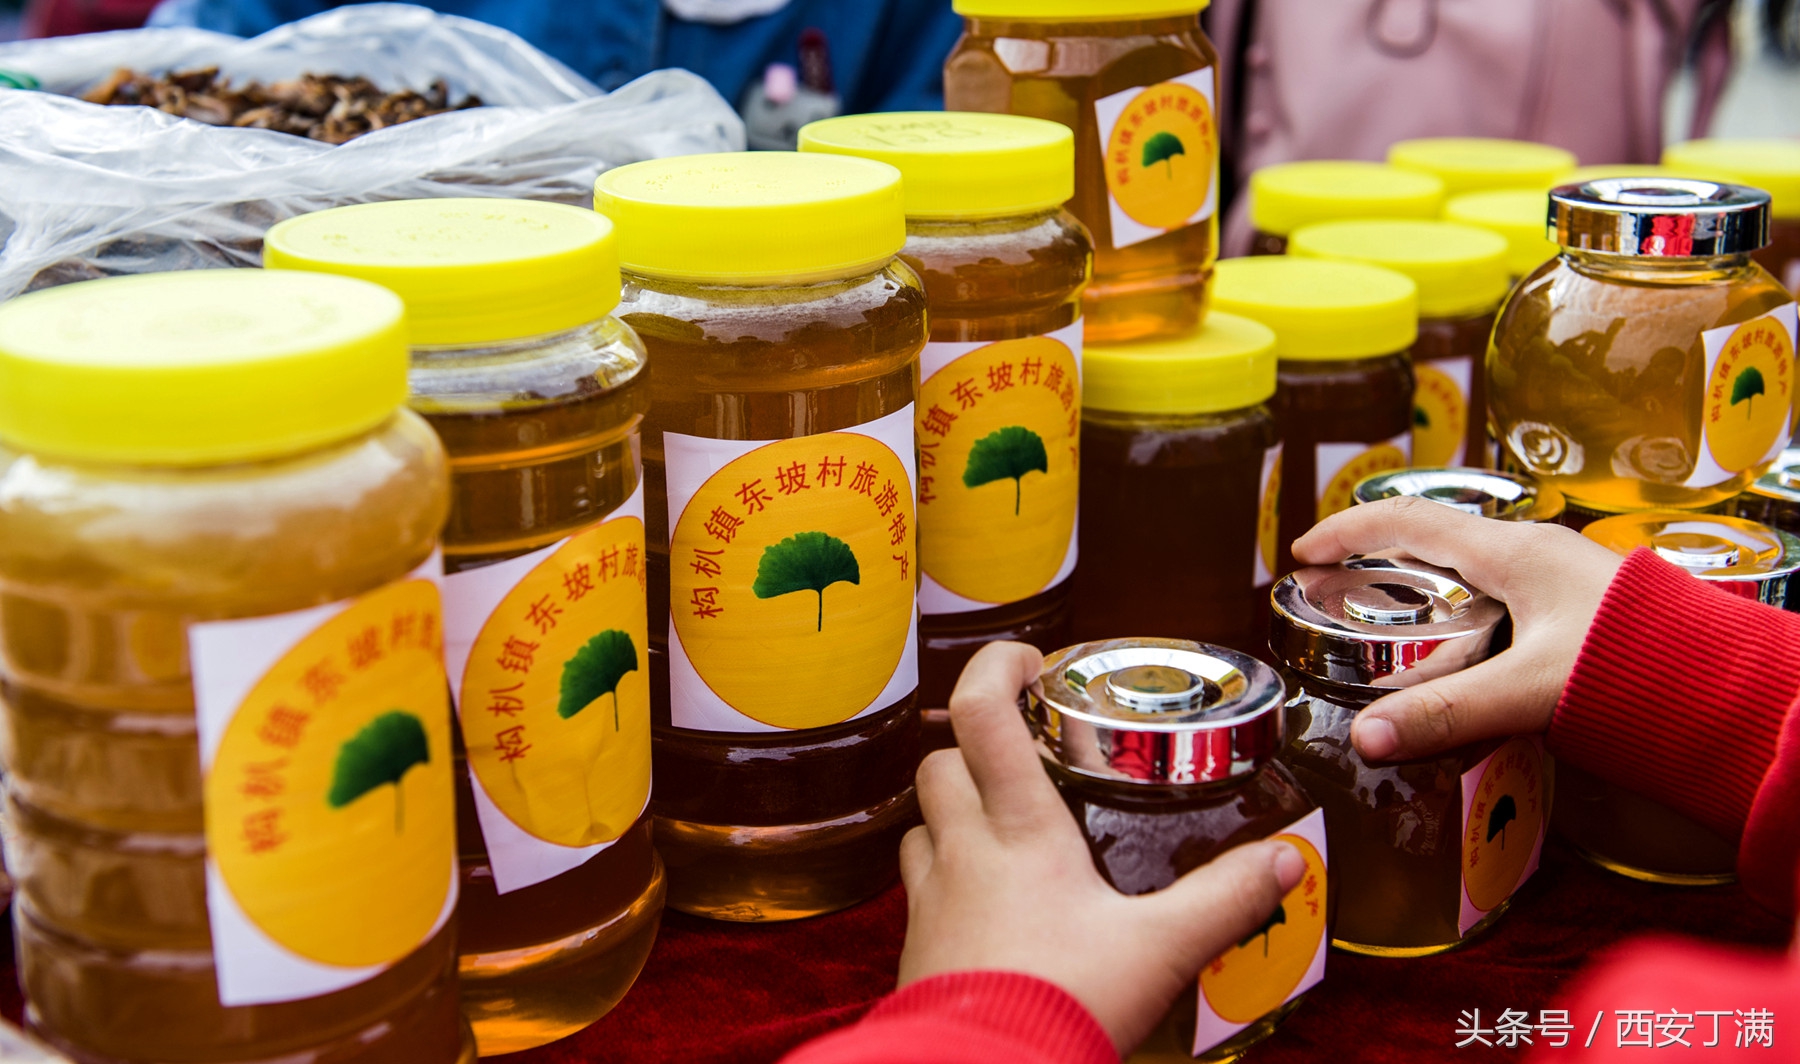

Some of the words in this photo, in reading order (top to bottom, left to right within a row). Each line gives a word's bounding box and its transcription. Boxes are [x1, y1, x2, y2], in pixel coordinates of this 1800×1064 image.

[690, 455, 909, 620] 构朳镇东坡村旅游特产
